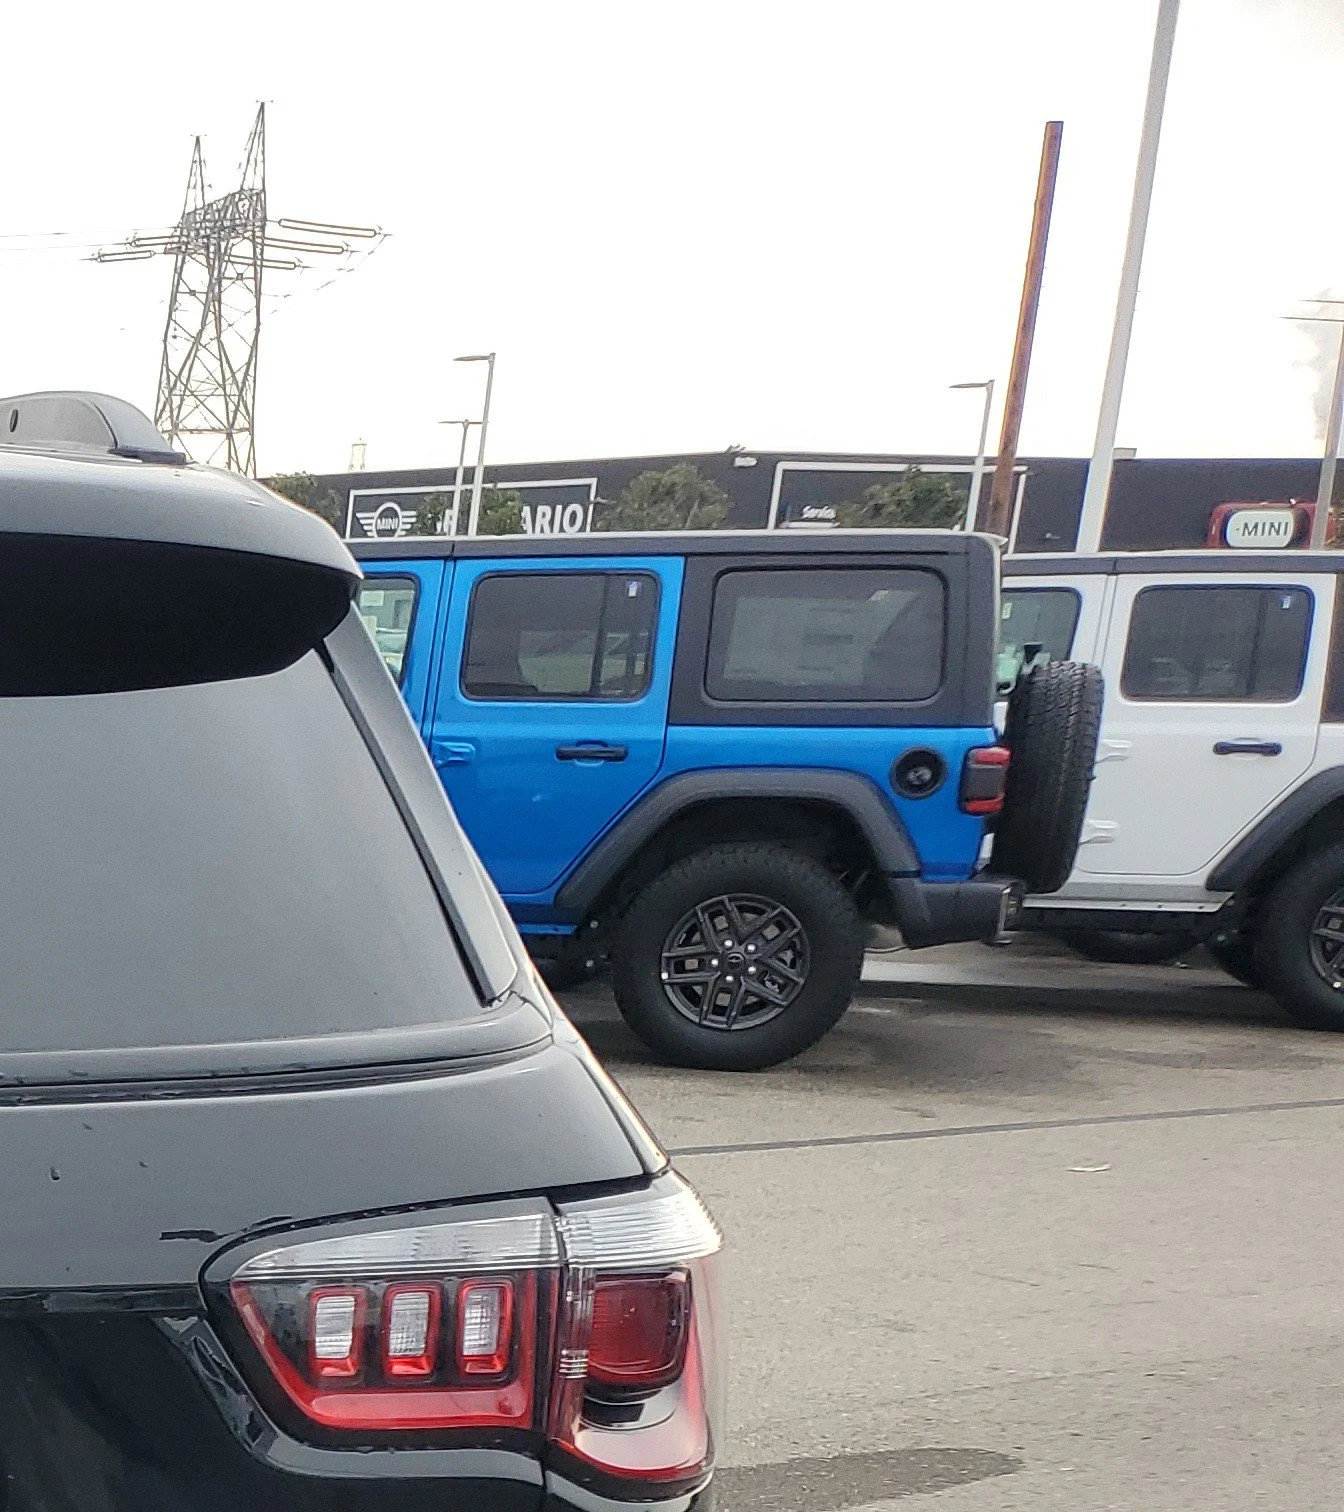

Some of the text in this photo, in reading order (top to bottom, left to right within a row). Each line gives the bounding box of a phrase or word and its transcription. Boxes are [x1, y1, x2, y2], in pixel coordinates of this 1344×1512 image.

[376, 504, 584, 534] MINI ARIO
[1241, 521, 1290, 537] MINI
